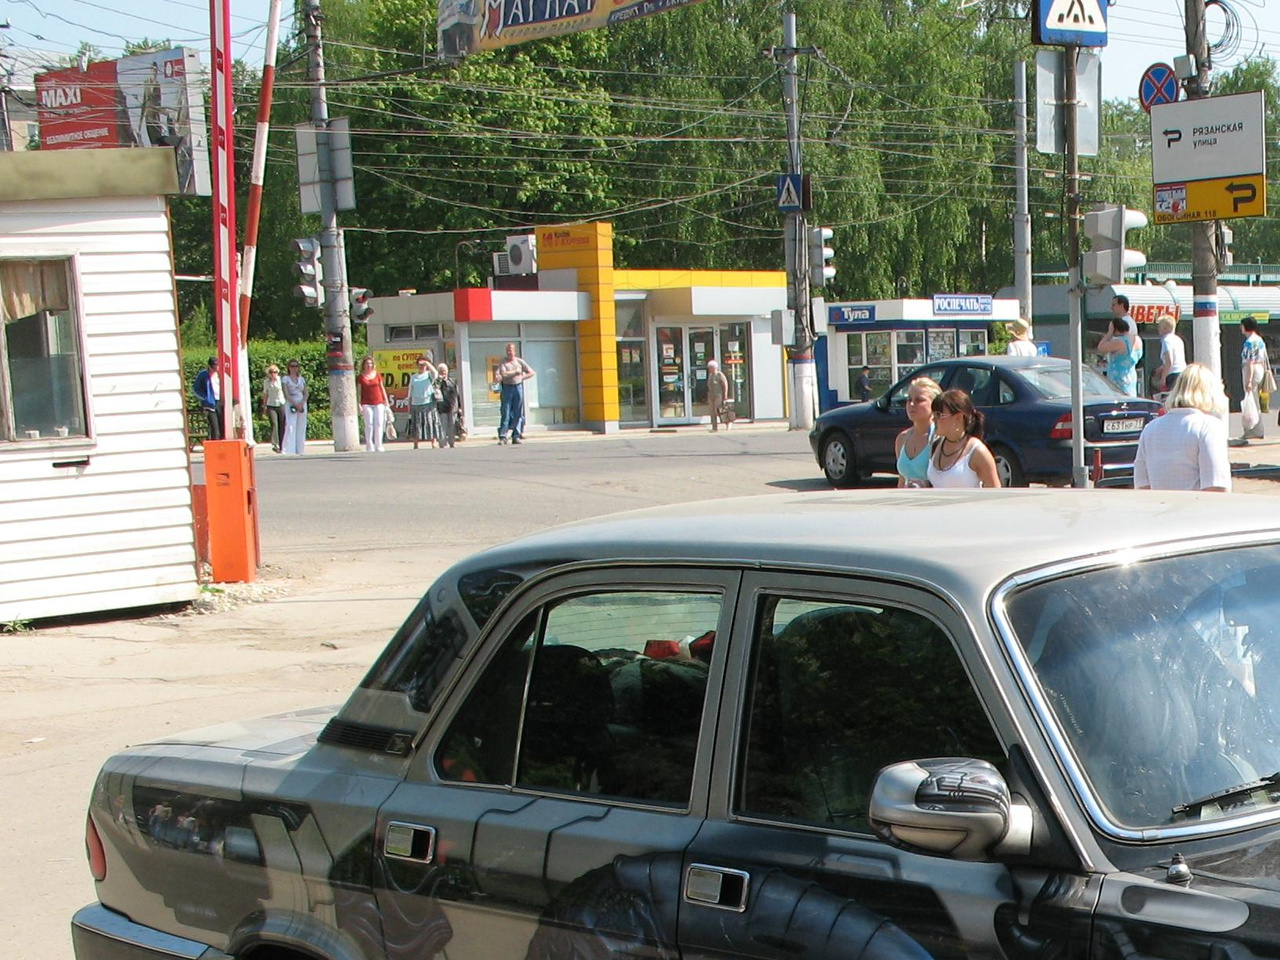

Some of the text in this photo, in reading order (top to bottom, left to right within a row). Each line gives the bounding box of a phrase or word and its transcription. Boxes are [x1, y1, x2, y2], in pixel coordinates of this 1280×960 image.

[42, 87, 82, 108] MAXI
[1193, 122, 1243, 137] РЯЗАНСКАЯ
[1192, 137, 1217, 149] улица
[1205, 210, 1217, 218] 118
[936, 296, 979, 311] РОСПЕЧАТЬ
[841, 307, 870, 322] Тула
